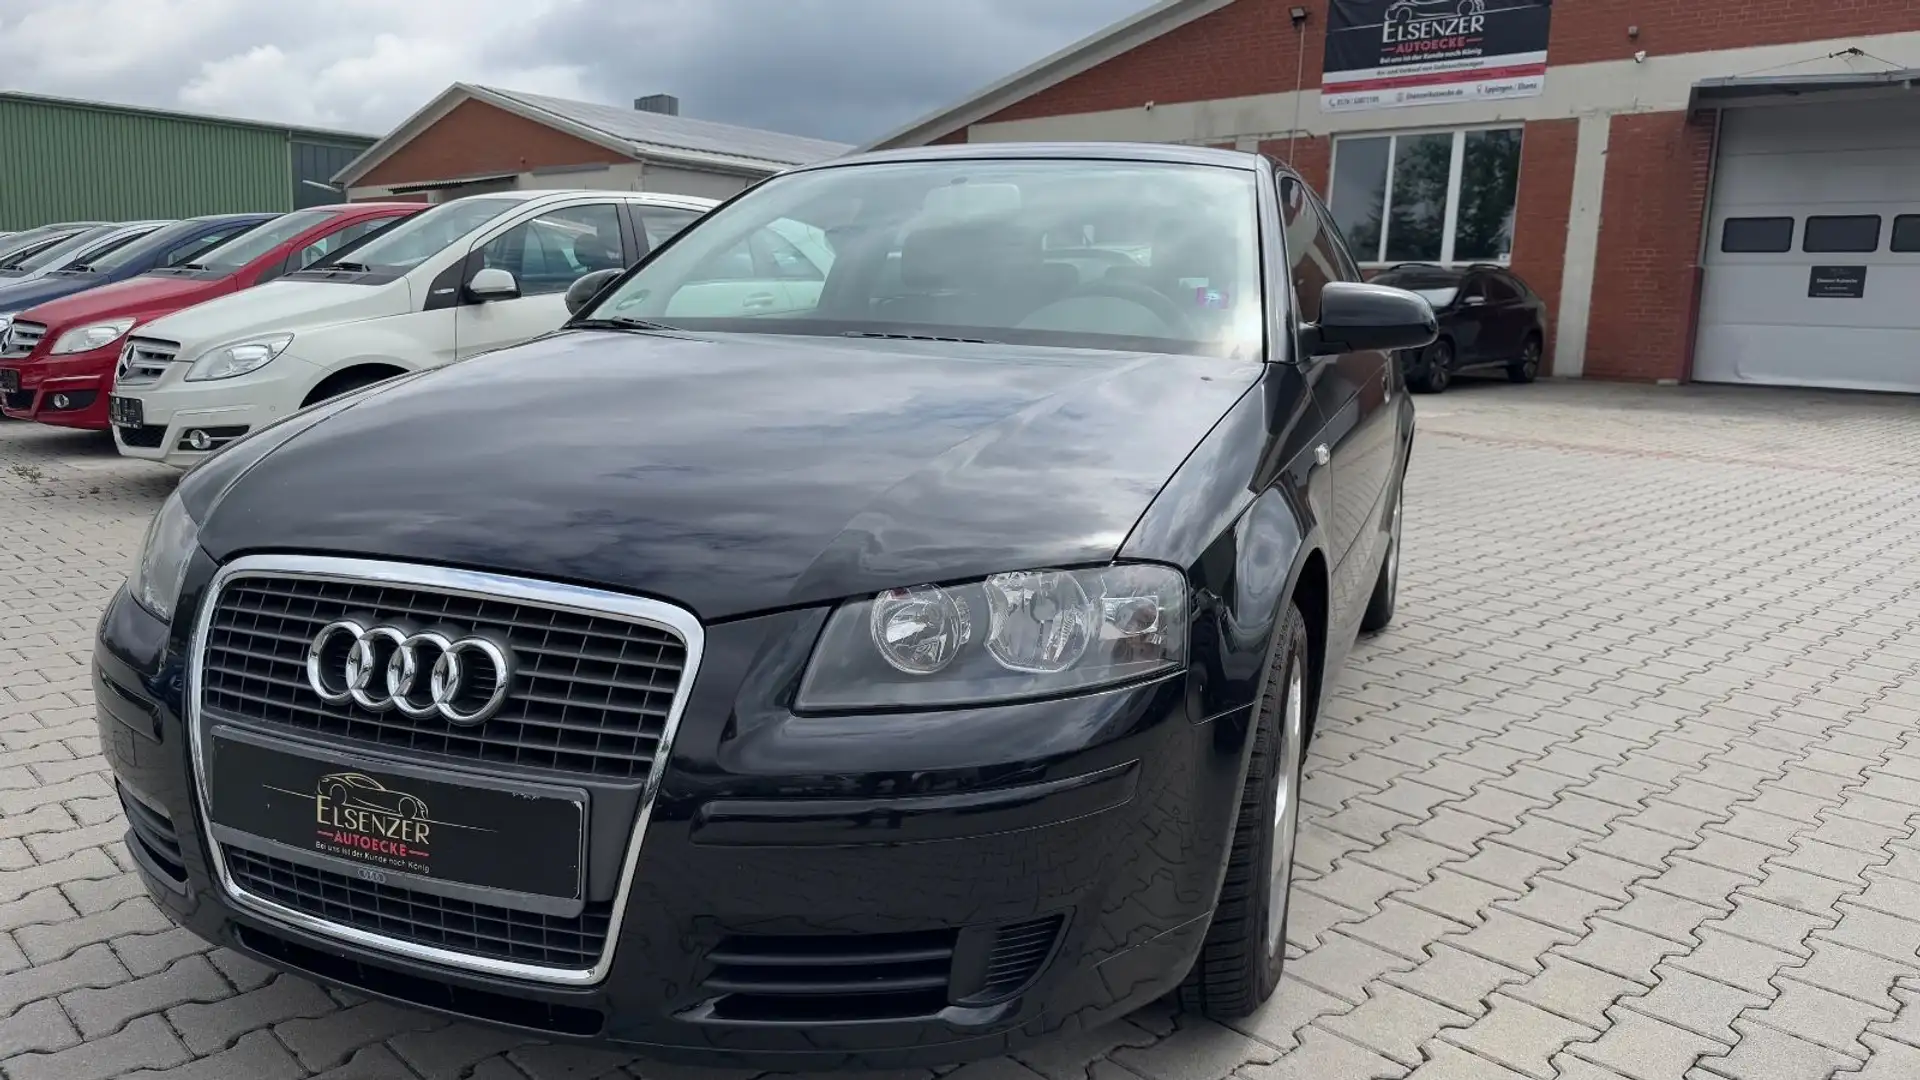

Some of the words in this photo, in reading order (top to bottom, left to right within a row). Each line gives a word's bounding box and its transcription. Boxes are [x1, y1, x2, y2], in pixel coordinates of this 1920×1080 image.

[1382, 15, 1484, 43] ELSENZER
[1396, 36, 1466, 53] AUTOECKE
[317, 794, 430, 845] ELSENZER
[316, 841, 326, 850] Bei
[352, 849, 364, 858] der
[364, 851, 388, 864] Kunde
[334, 831, 407, 857] AUTOECKE
